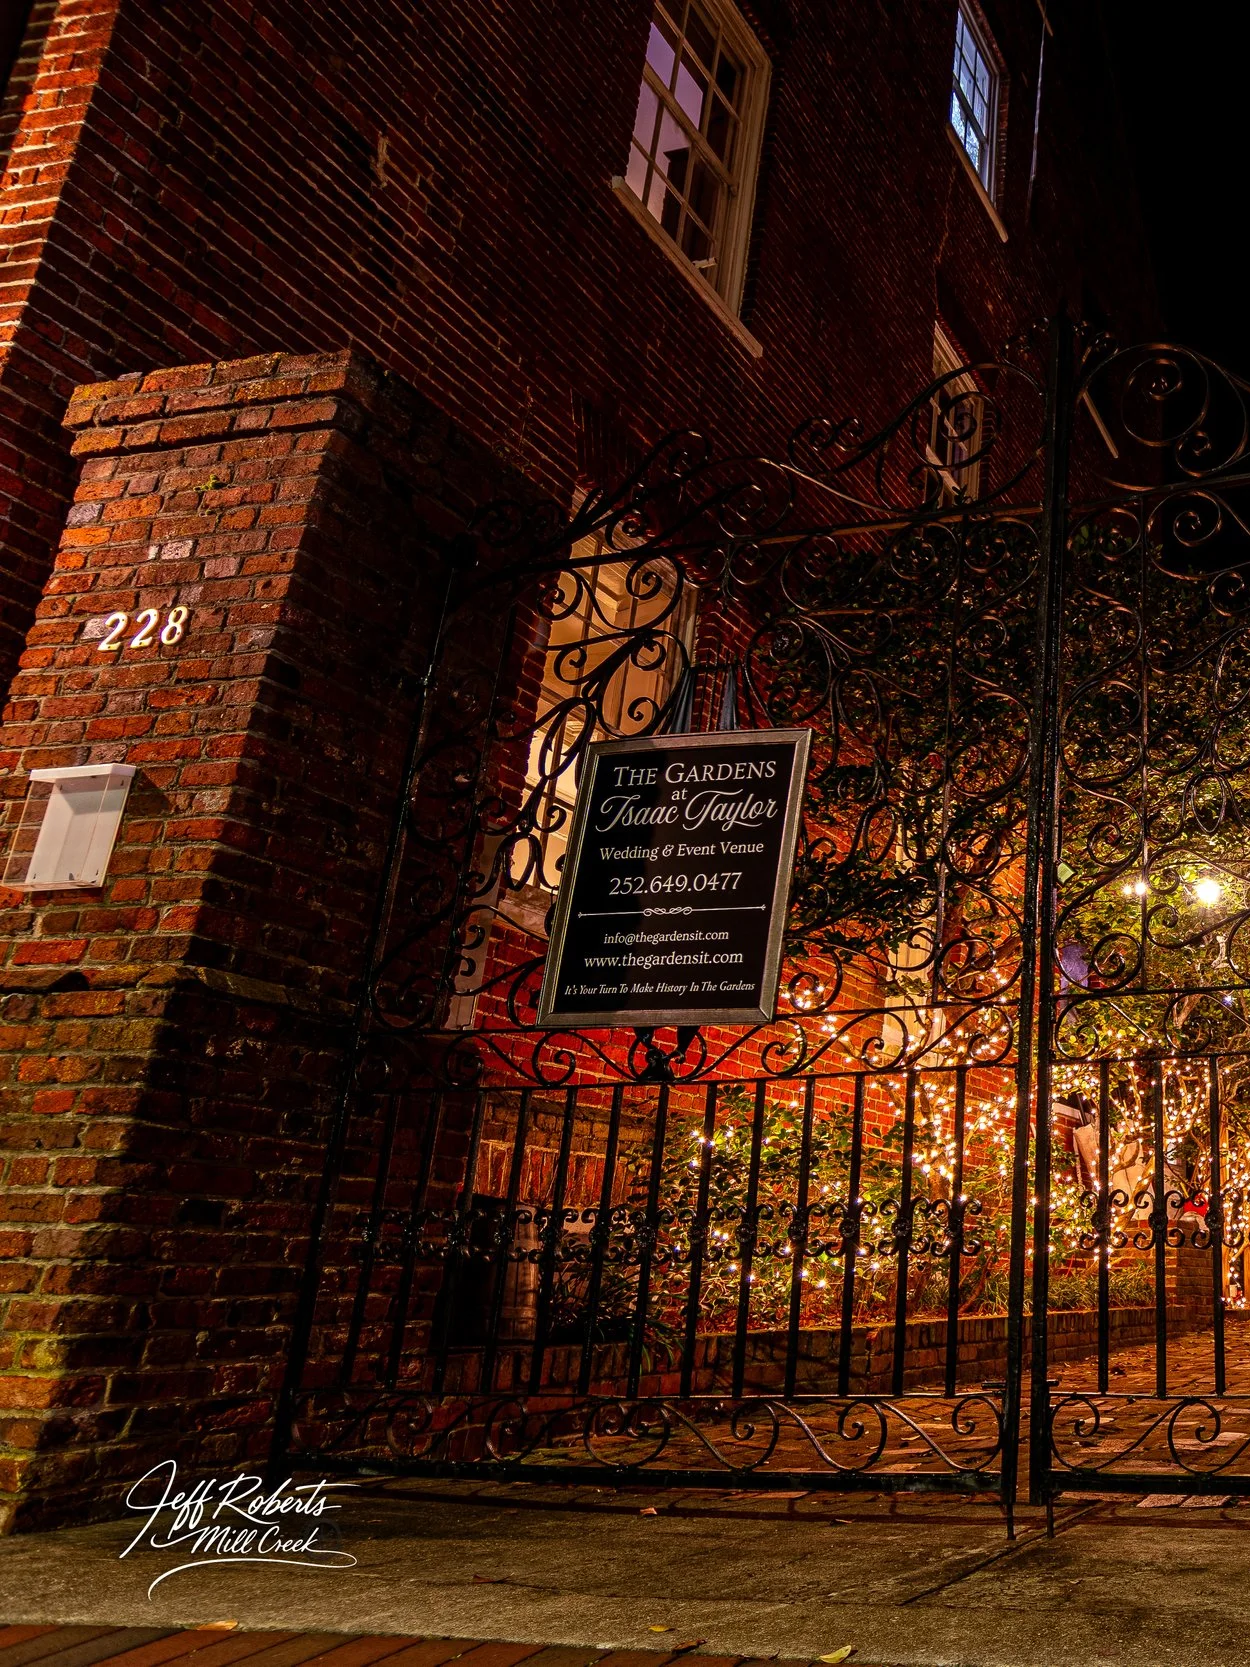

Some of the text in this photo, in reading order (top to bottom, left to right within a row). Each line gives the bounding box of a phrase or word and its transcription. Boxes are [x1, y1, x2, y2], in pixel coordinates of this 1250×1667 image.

[97, 605, 190, 651] 228
[613, 761, 777, 787] THE GARDENS
[671, 788, 688, 801] at
[595, 788, 778, 832] Isaac Taylor
[600, 842, 764, 861] Wedding & Event Venue
[608, 872, 743, 895] 252.649.0477
[603, 930, 729, 945] info@thegardensit.com
[584, 951, 743, 969] www.thegardensit.com
[564, 980, 755, 996] It's Your Turn To Make History In The Gardens
